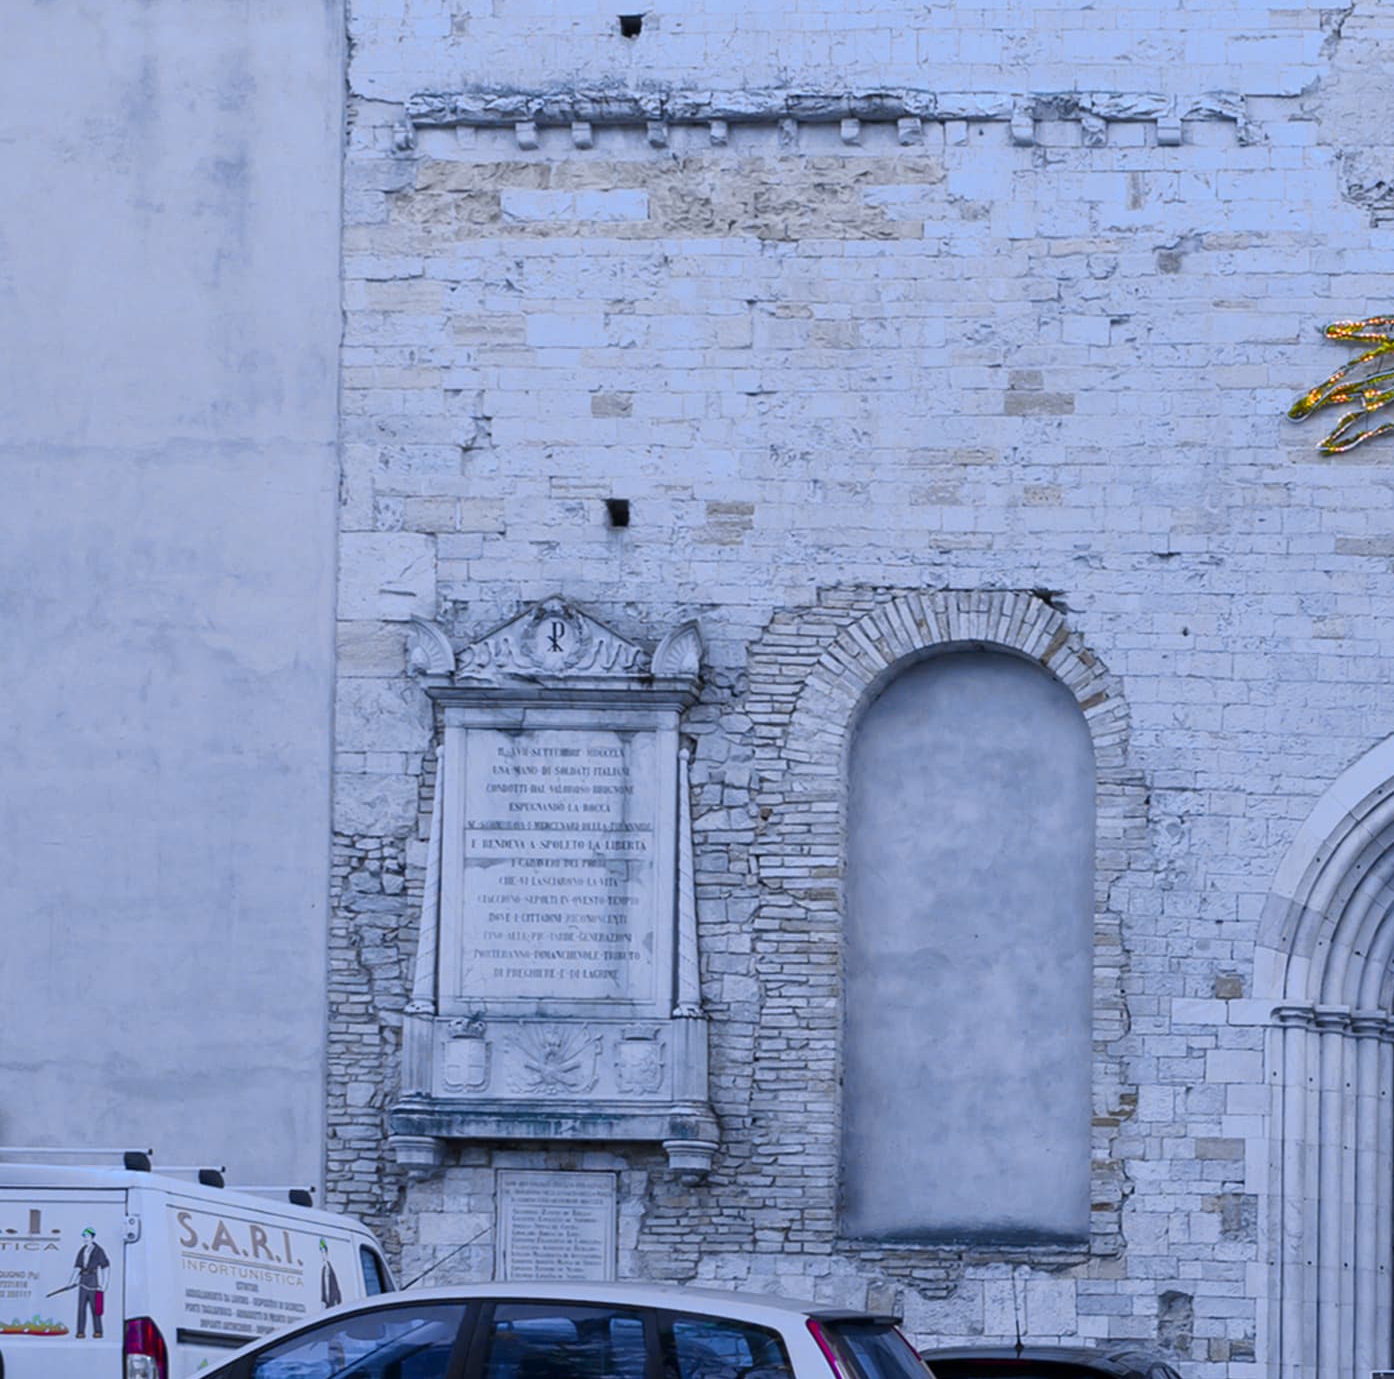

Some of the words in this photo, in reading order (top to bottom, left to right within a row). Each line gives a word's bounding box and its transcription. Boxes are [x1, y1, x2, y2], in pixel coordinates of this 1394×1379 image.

[482, 840, 526, 850] RENDEVA
[540, 840, 584, 850] SPOLETO
[588, 840, 601, 850] LA
[177, 1211, 304, 1266] S.A.R.I.
[182, 1259, 305, 1287] INFORTUNISTICA
